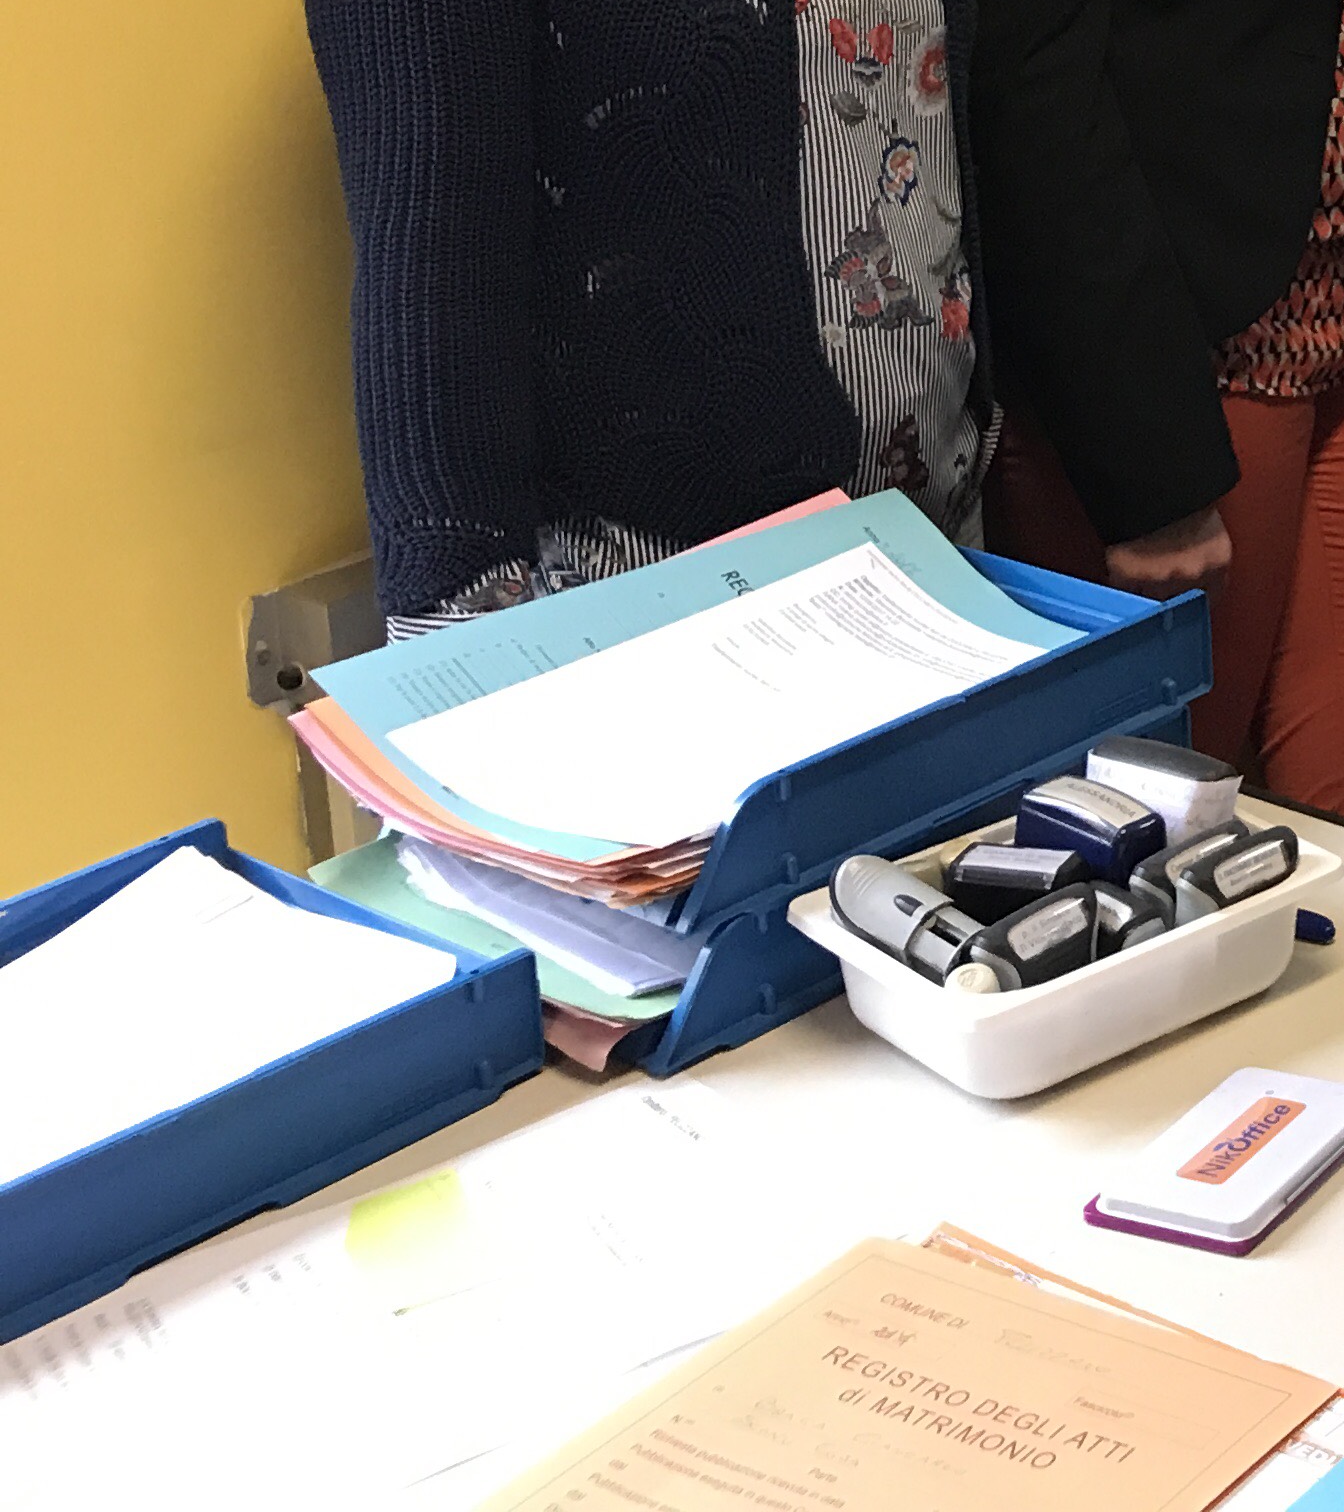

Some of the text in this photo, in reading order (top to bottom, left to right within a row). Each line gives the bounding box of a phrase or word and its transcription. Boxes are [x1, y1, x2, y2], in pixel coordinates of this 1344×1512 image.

[880, 1292, 971, 1331] COMUNE DI
[821, 1345, 972, 1409] REGISTRO
[971, 1397, 1067, 1441] DEGLI
[1063, 1430, 1138, 1465] ATTI
[838, 1386, 864, 1406] di
[866, 1395, 1058, 1471] MATRIMONIO
